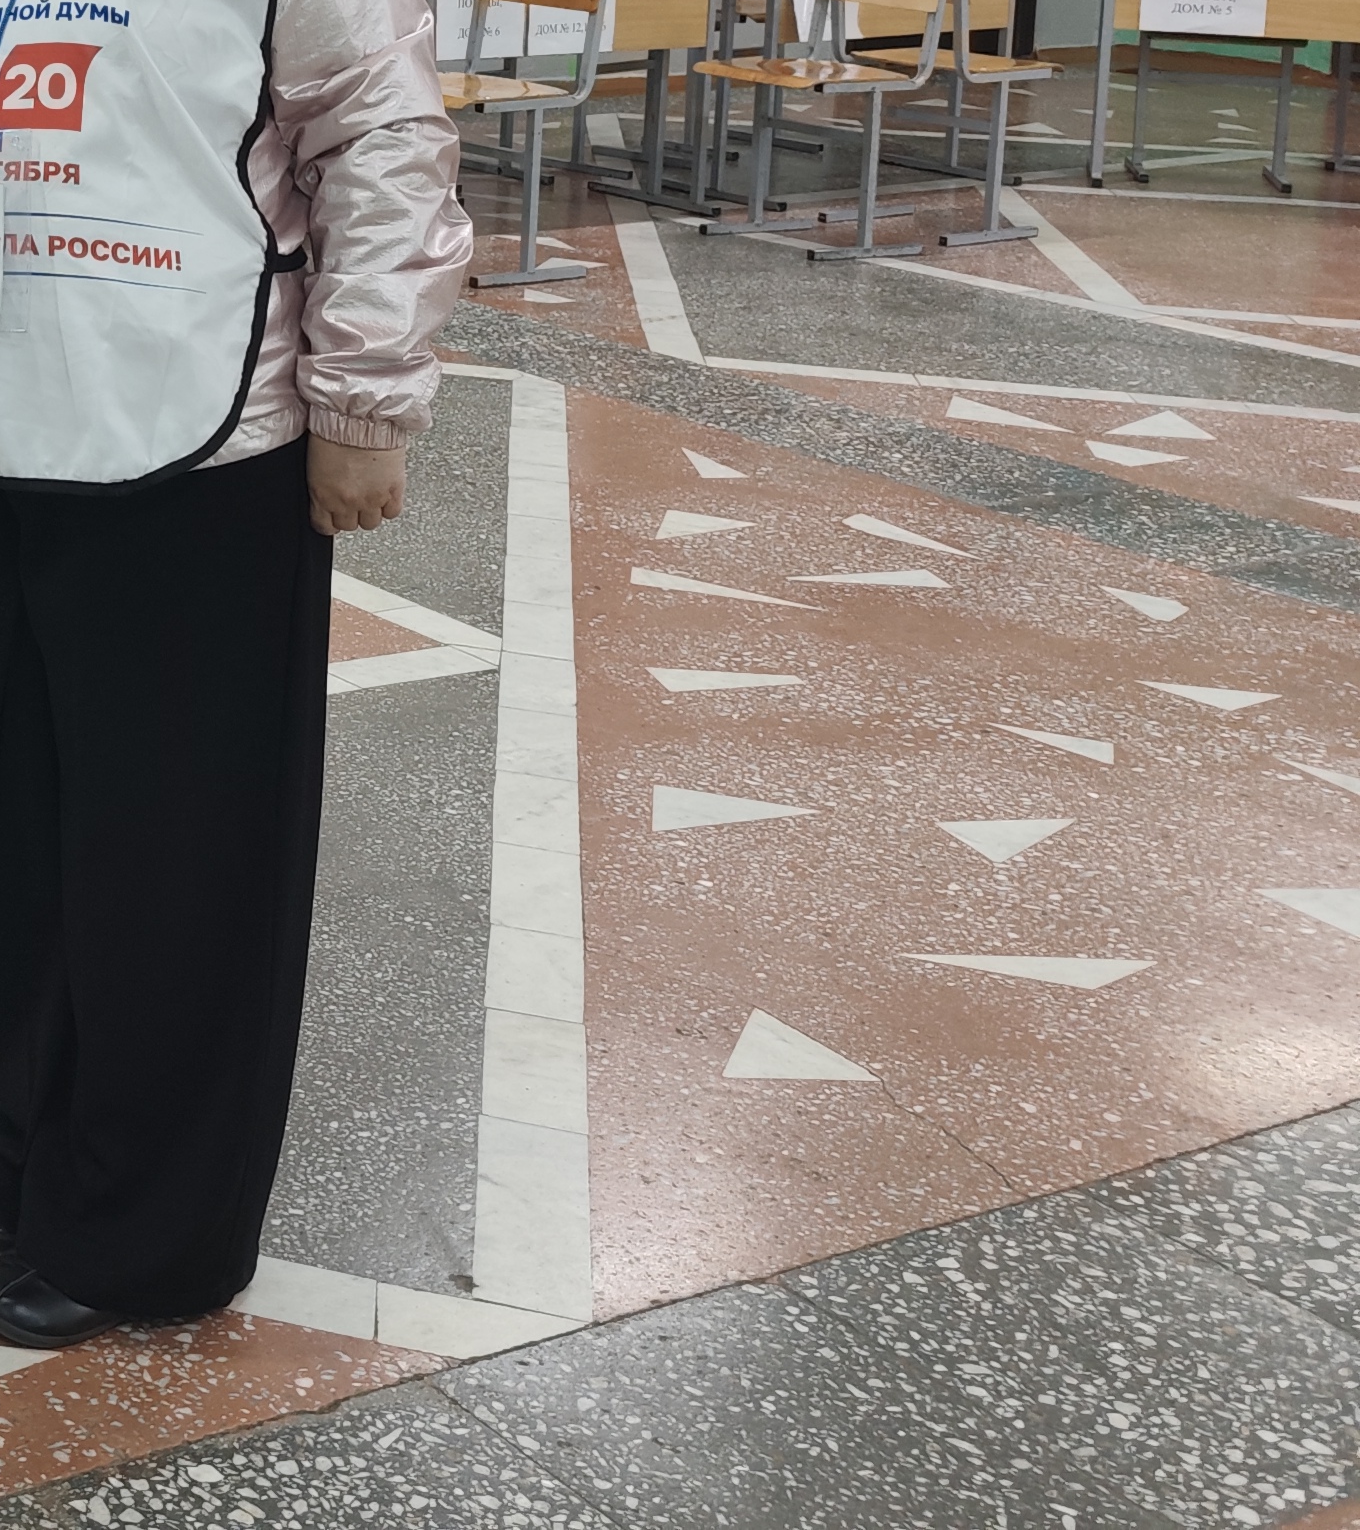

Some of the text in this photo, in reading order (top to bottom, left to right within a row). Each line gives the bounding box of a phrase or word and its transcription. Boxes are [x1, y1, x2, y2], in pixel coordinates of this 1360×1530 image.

[56, 1, 130, 27] ДУМЫ
[1171, 3, 1232, 15] ДОМ № 5
[495, 27, 501, 36] 6
[535, 23, 558, 36] ДОМ
[559, 23, 569, 34] №
[1, 62, 78, 110] 20
[48, 235, 182, 272] РОССИИ!
